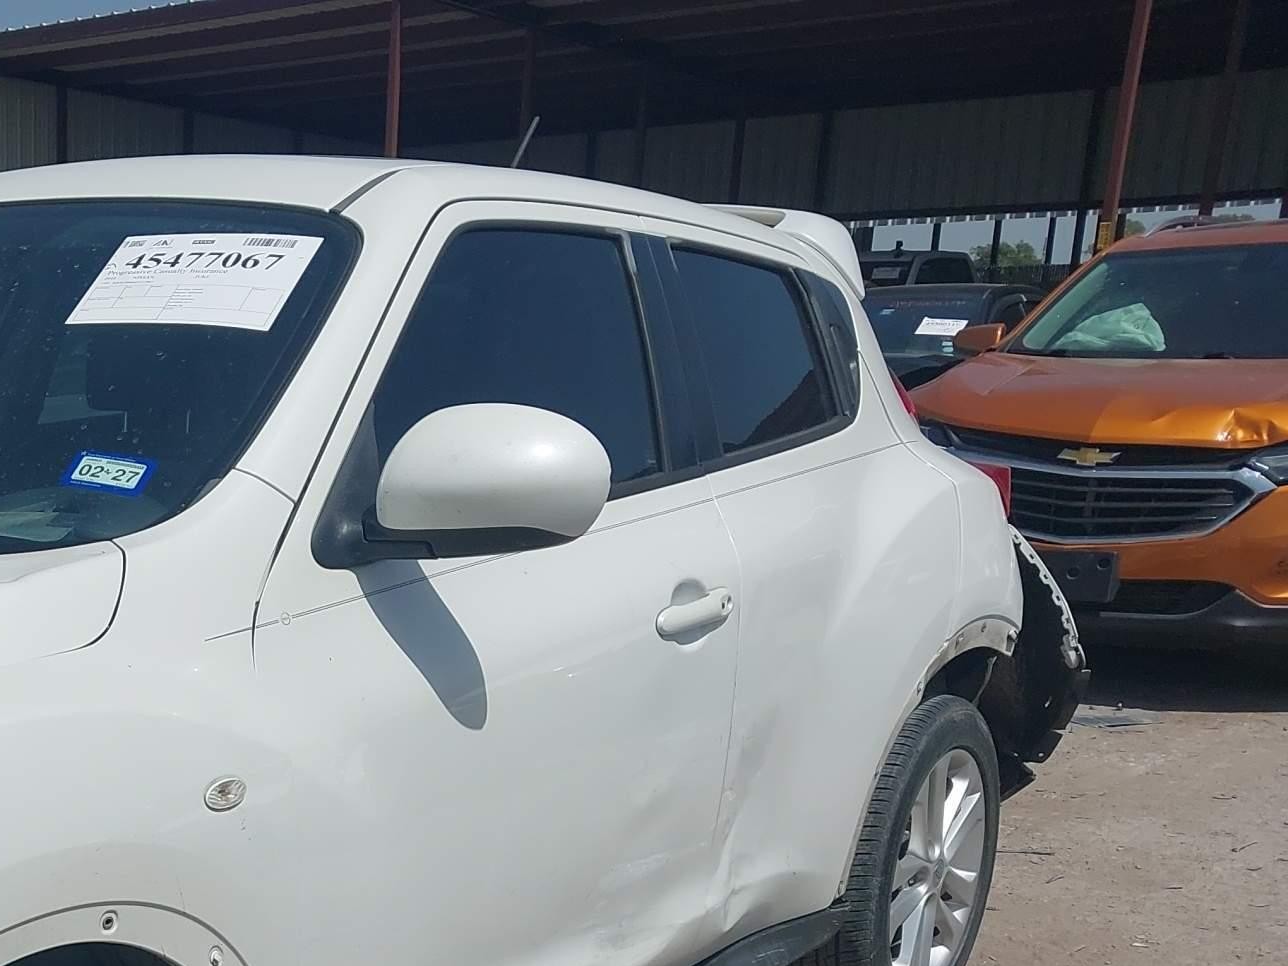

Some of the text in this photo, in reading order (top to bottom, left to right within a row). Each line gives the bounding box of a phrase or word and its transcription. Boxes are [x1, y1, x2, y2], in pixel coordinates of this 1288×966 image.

[125, 251, 286, 270] 45477067
[78, 463, 105, 479] 02
[110, 468, 141, 483] 27
